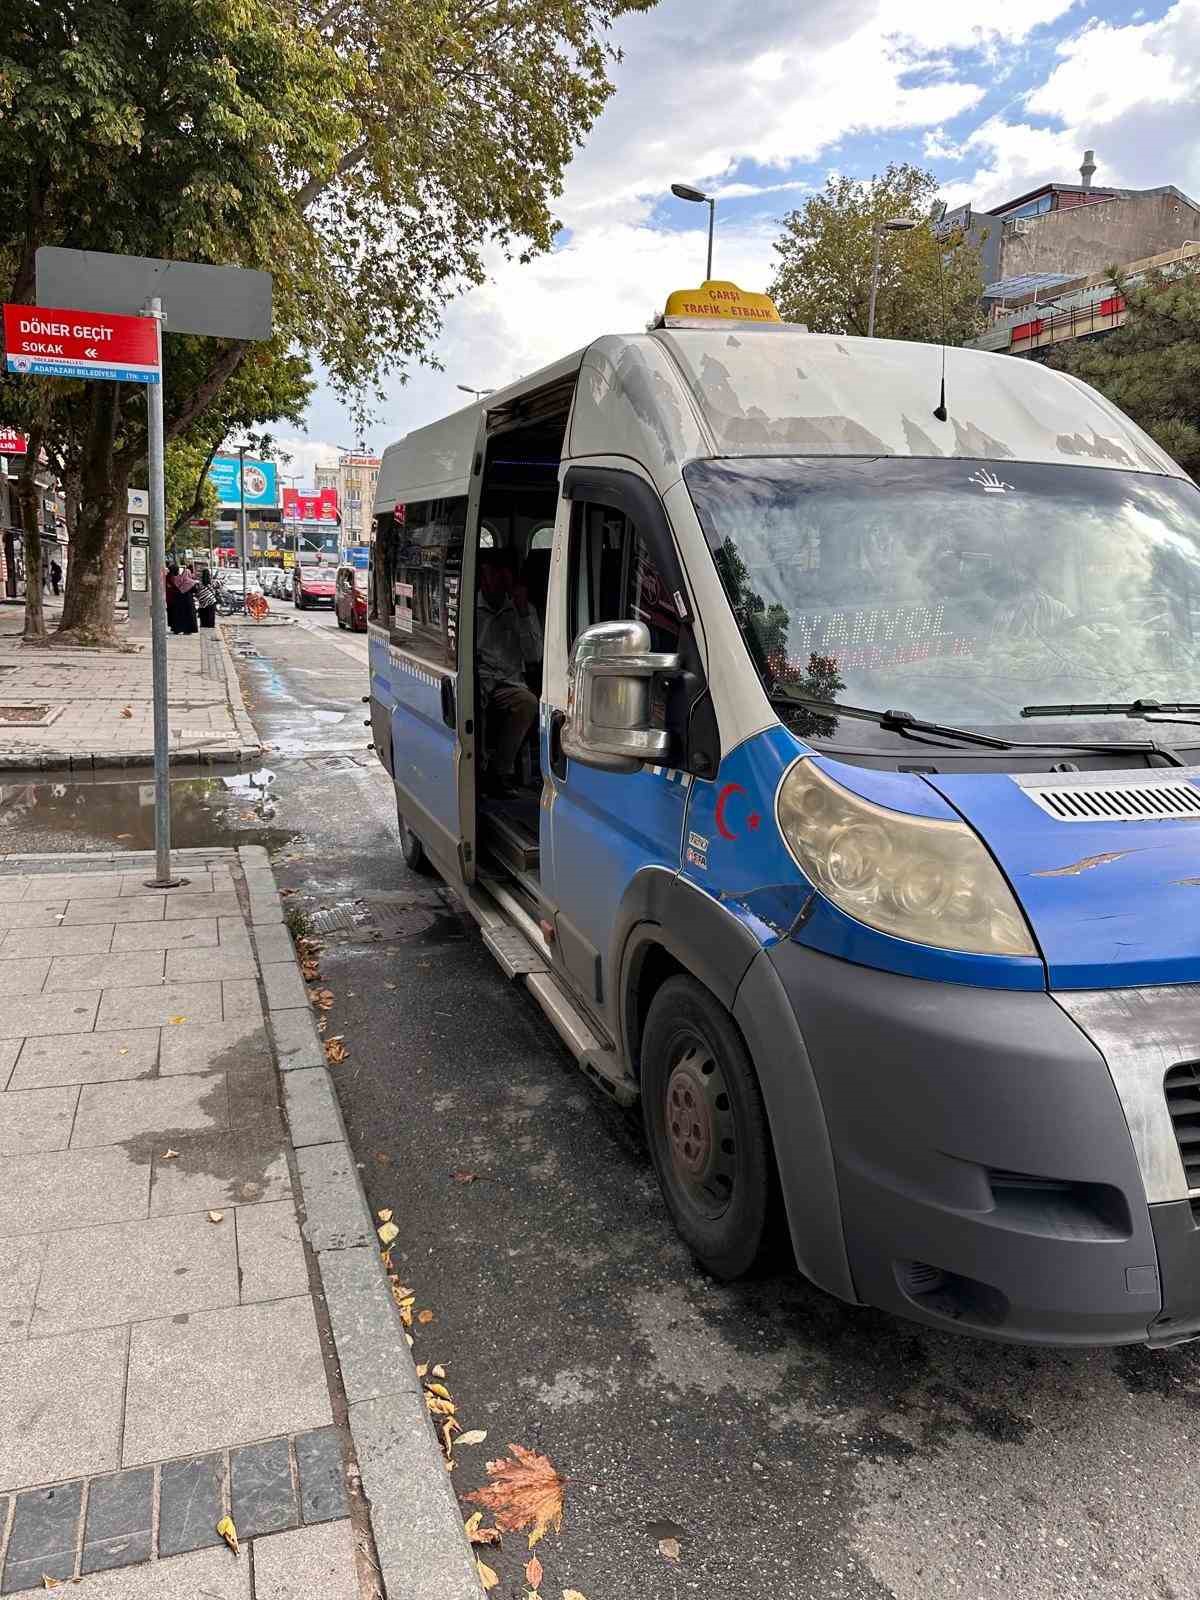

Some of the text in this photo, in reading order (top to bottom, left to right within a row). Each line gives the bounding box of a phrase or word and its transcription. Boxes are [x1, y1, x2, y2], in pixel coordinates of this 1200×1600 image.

[682, 303, 721, 314] TRAFİK
[730, 305, 772, 318] ETBALIK
[20, 318, 114, 342] DÖNER GEÇİT
[22, 341, 64, 354] SOKAK
[34, 365, 76, 374] ADAPAZARI
